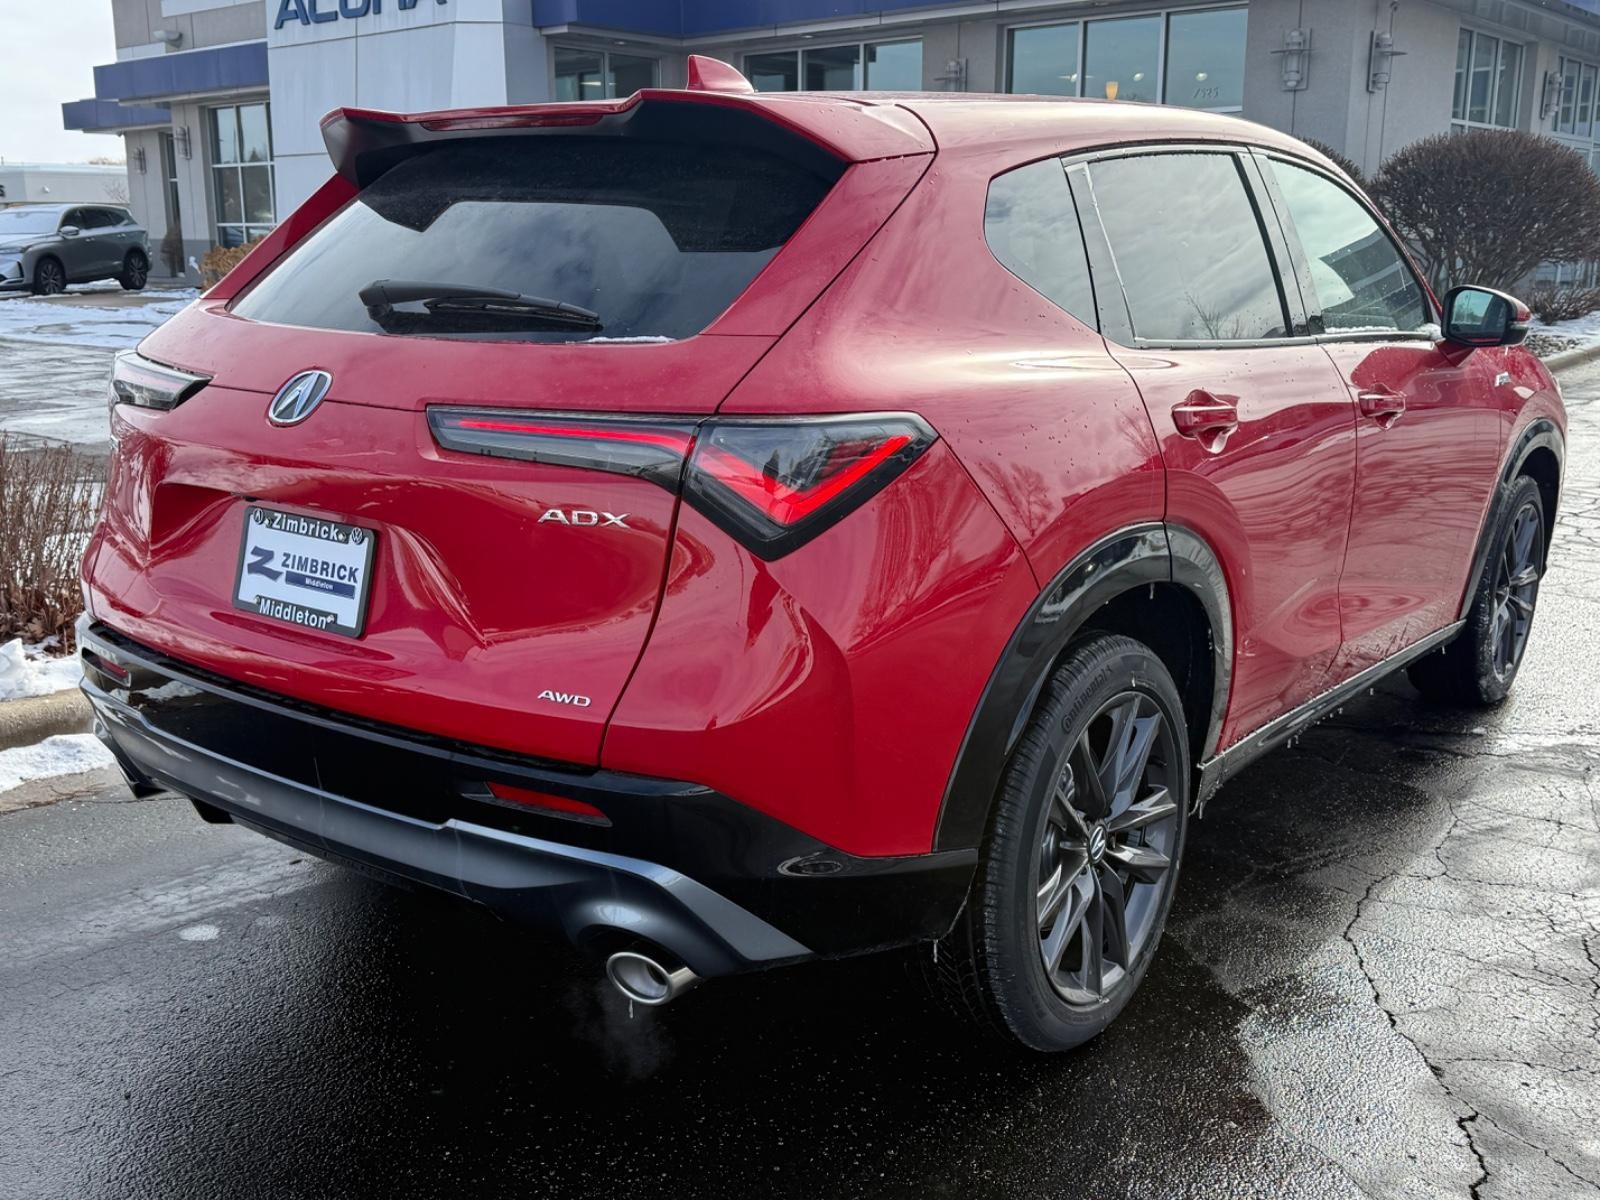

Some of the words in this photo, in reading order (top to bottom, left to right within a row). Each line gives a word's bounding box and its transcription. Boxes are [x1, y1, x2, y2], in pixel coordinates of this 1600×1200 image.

[271, 511, 340, 542] Zimbrick
[537, 508, 631, 529] ADX
[281, 552, 359, 584] ZIMBRICK
[259, 597, 327, 630] Middleton
[537, 689, 592, 707] AWD
